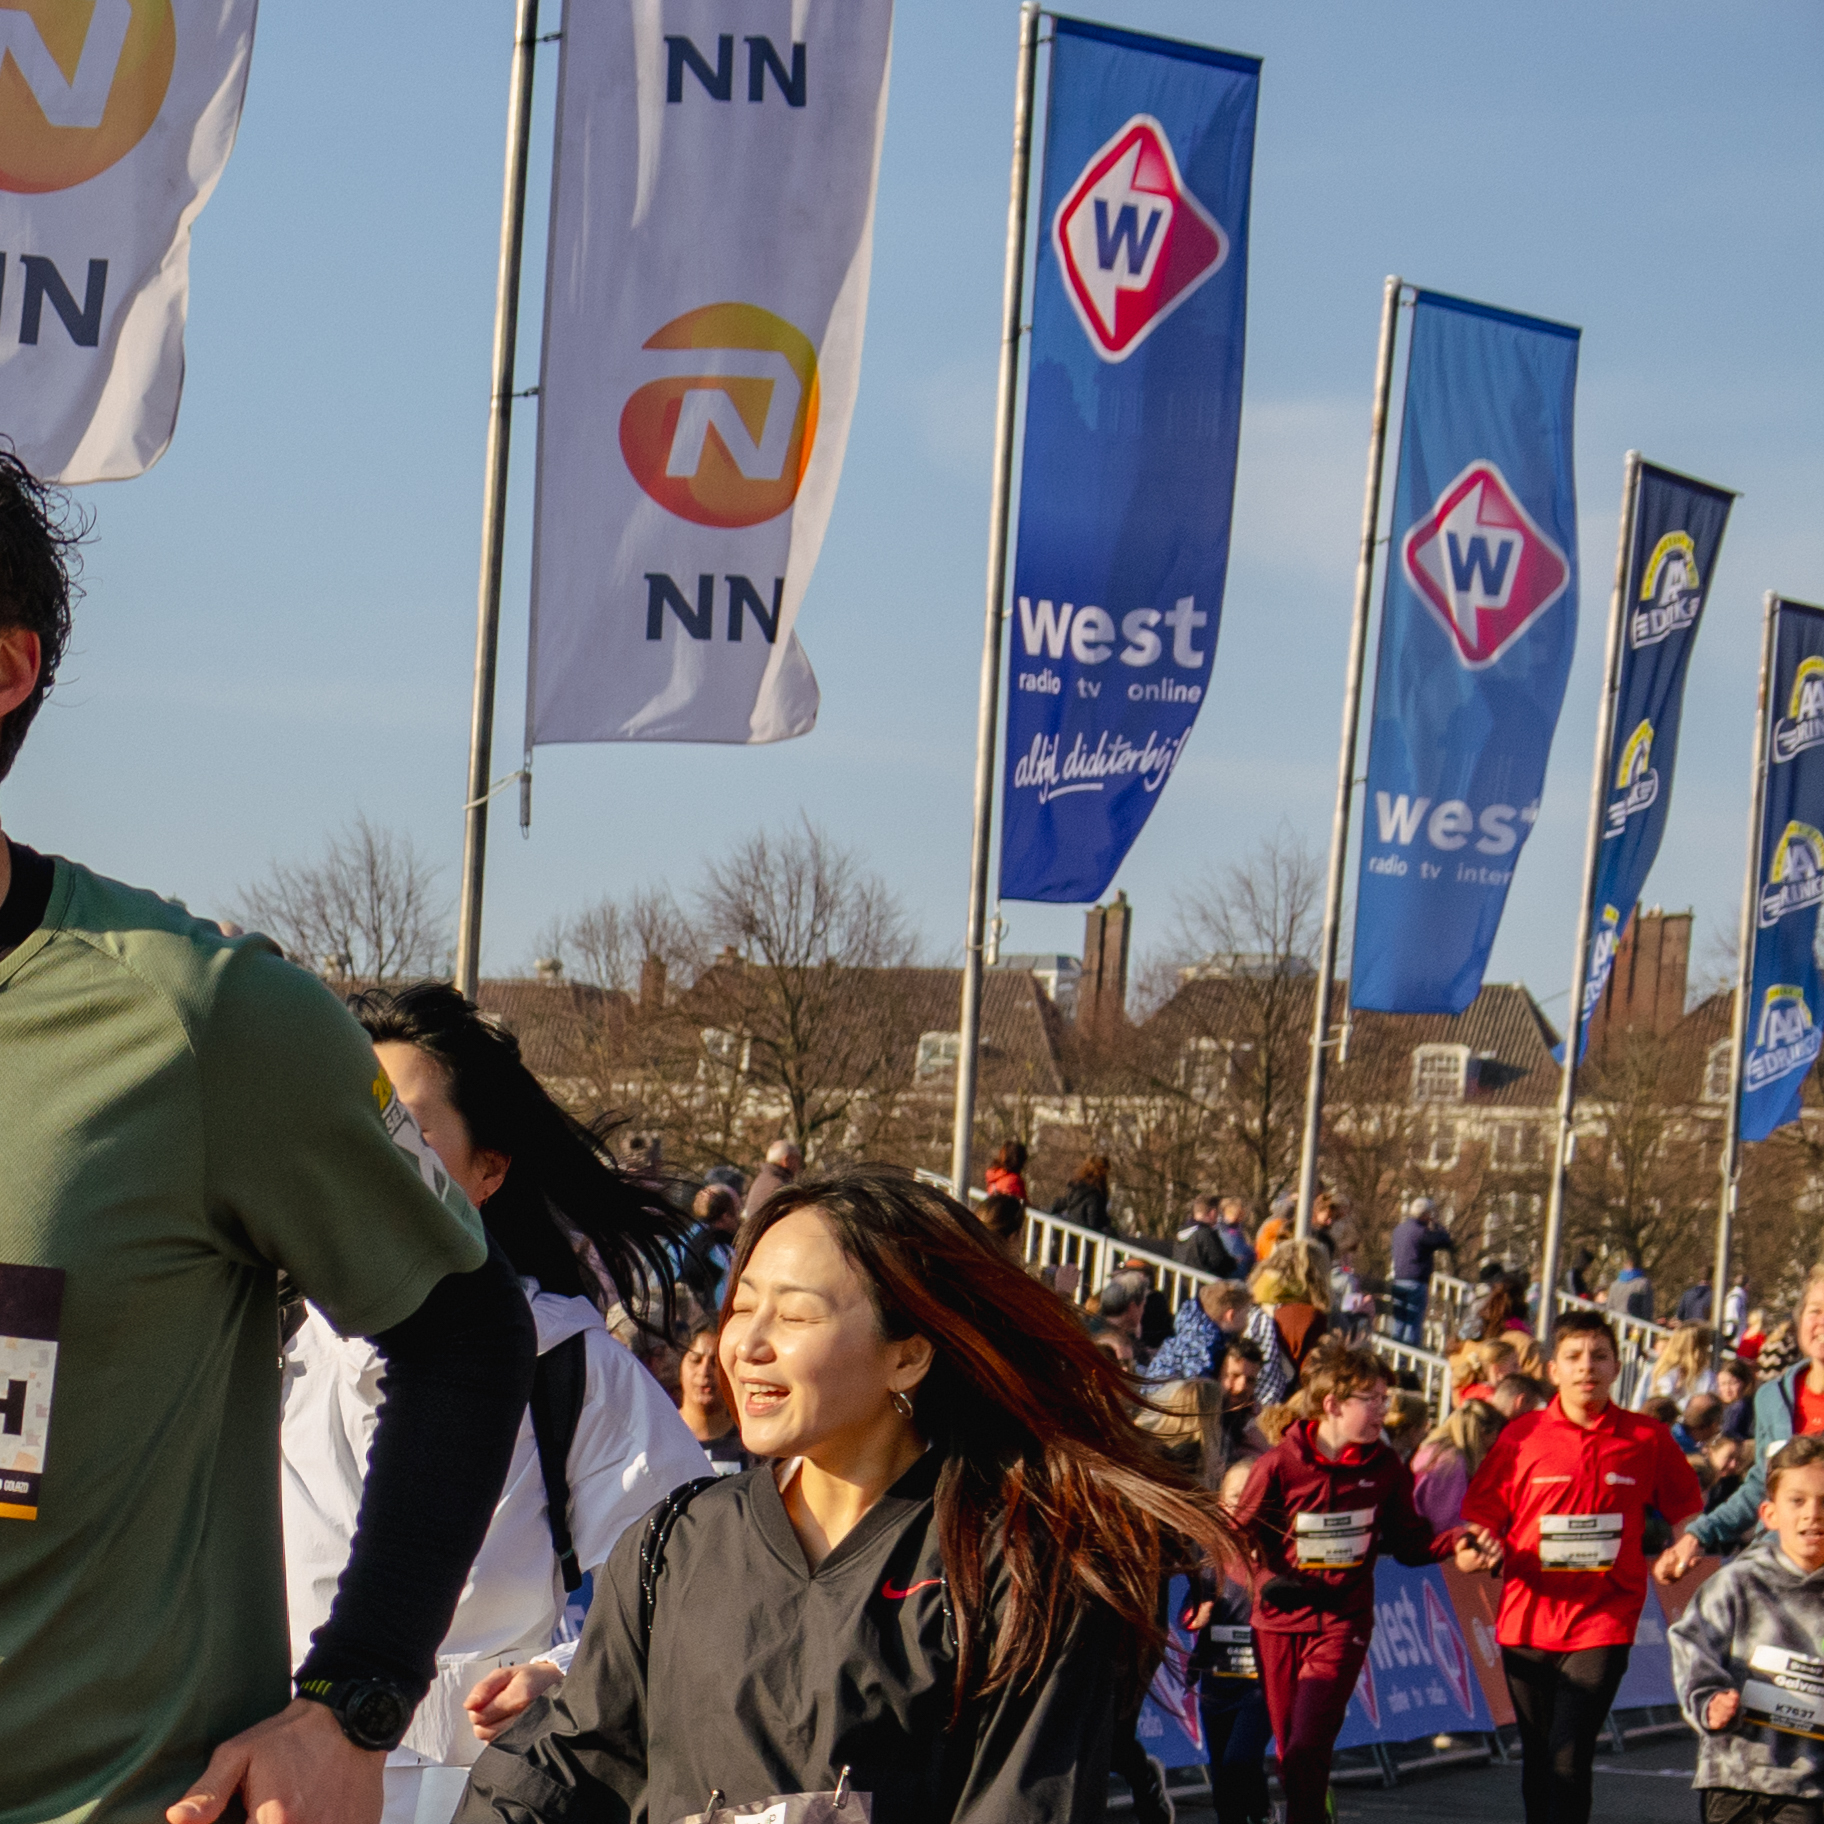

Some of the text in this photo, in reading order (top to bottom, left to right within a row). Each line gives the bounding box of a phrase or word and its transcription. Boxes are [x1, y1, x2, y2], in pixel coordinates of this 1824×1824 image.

[664, 34, 808, 108] NN
[1093, 196, 1164, 276] W
[1446, 530, 1513, 599] W
[643, 573, 785, 644] NN
[1018, 595, 1207, 669] west
[1018, 668, 1202, 703] radio tv online
[1456, 862, 1514, 887] inter
